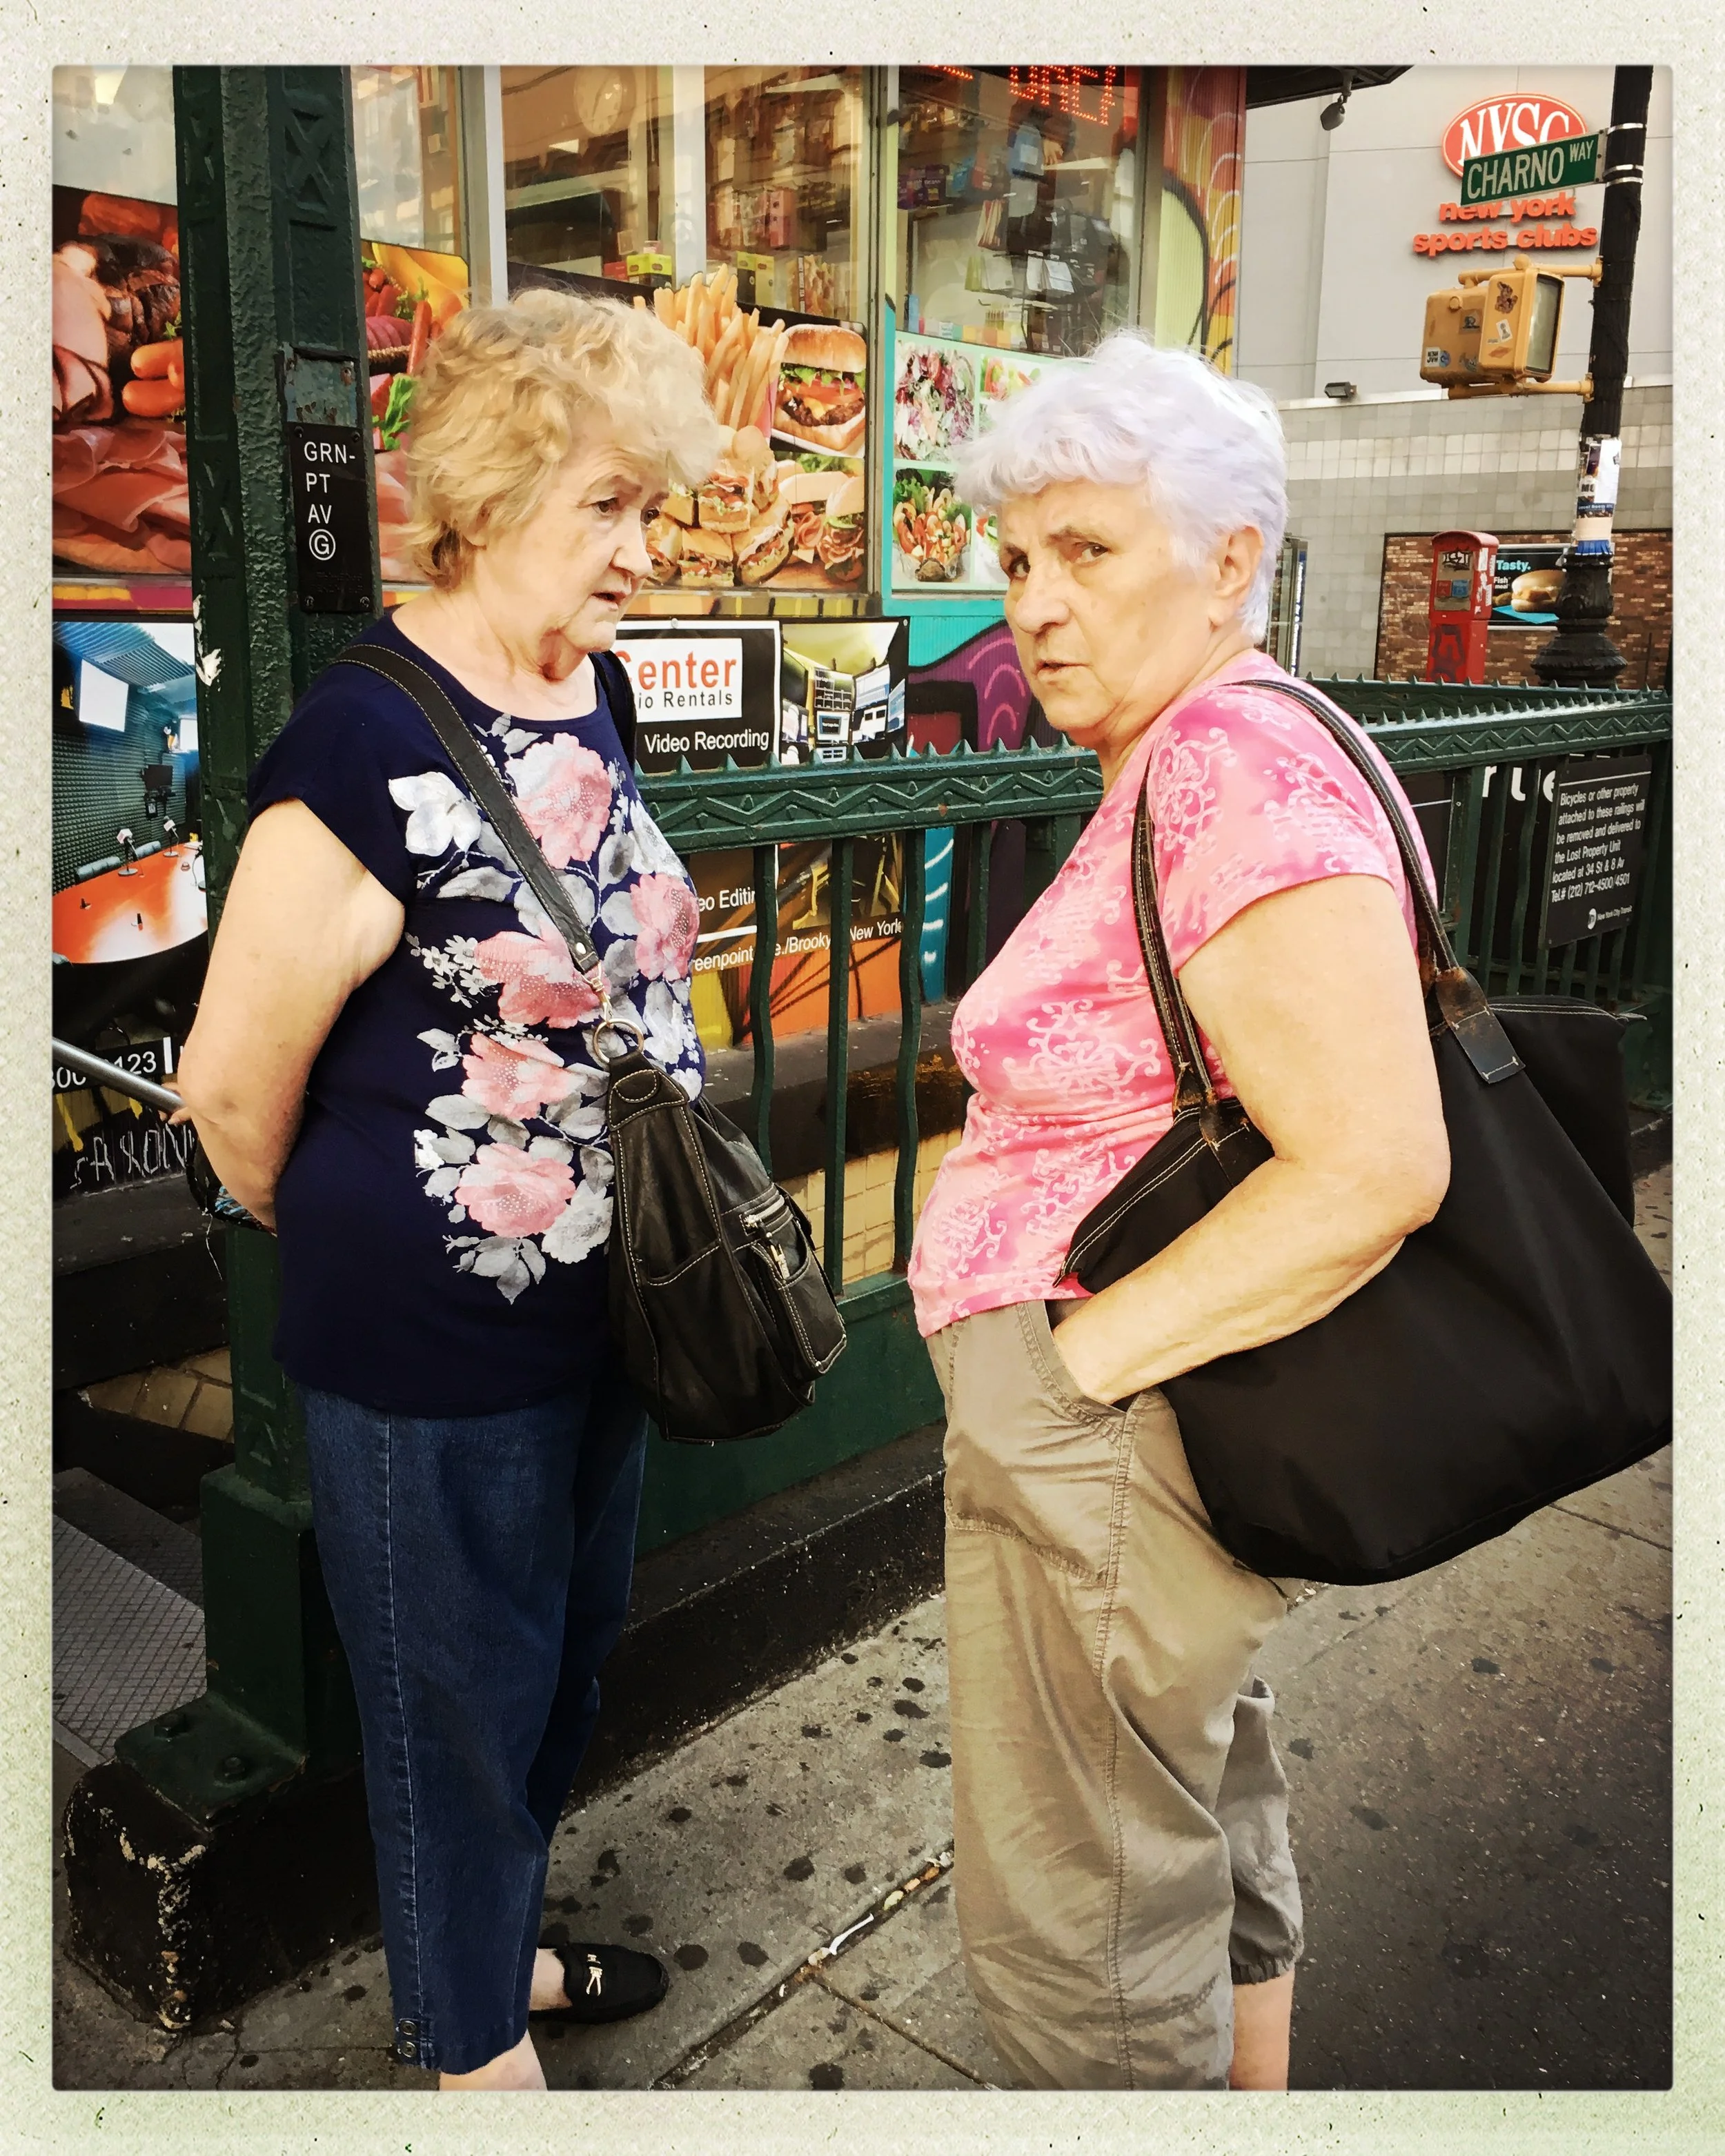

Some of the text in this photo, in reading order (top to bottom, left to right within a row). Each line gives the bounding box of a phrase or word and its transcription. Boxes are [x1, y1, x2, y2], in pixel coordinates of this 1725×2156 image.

[1467, 140, 1594, 199] CHARNO WAY
[1439, 192, 1576, 223] new york
[1413, 223, 1598, 257] sports clubs
[304, 442, 355, 464] GRN-
[306, 473, 331, 493] PT
[308, 504, 332, 524] AV
[1496, 560, 1530, 571] Tasty.
[664, 690, 732, 708] Rentals
[644, 728, 769, 754] Video Recording
[1561, 783, 1639, 807] Bicycles or other property
[1559, 799, 1645, 825] attached to these railings will
[1557, 819, 1641, 844] be removed and delivered to
[1555, 840, 1621, 864] the Lost Property Unit
[1552, 856, 1625, 883] located at 34 St & 8 Av
[1568, 882, 1583, 900] (212)
[877, 918, 902, 936] York
